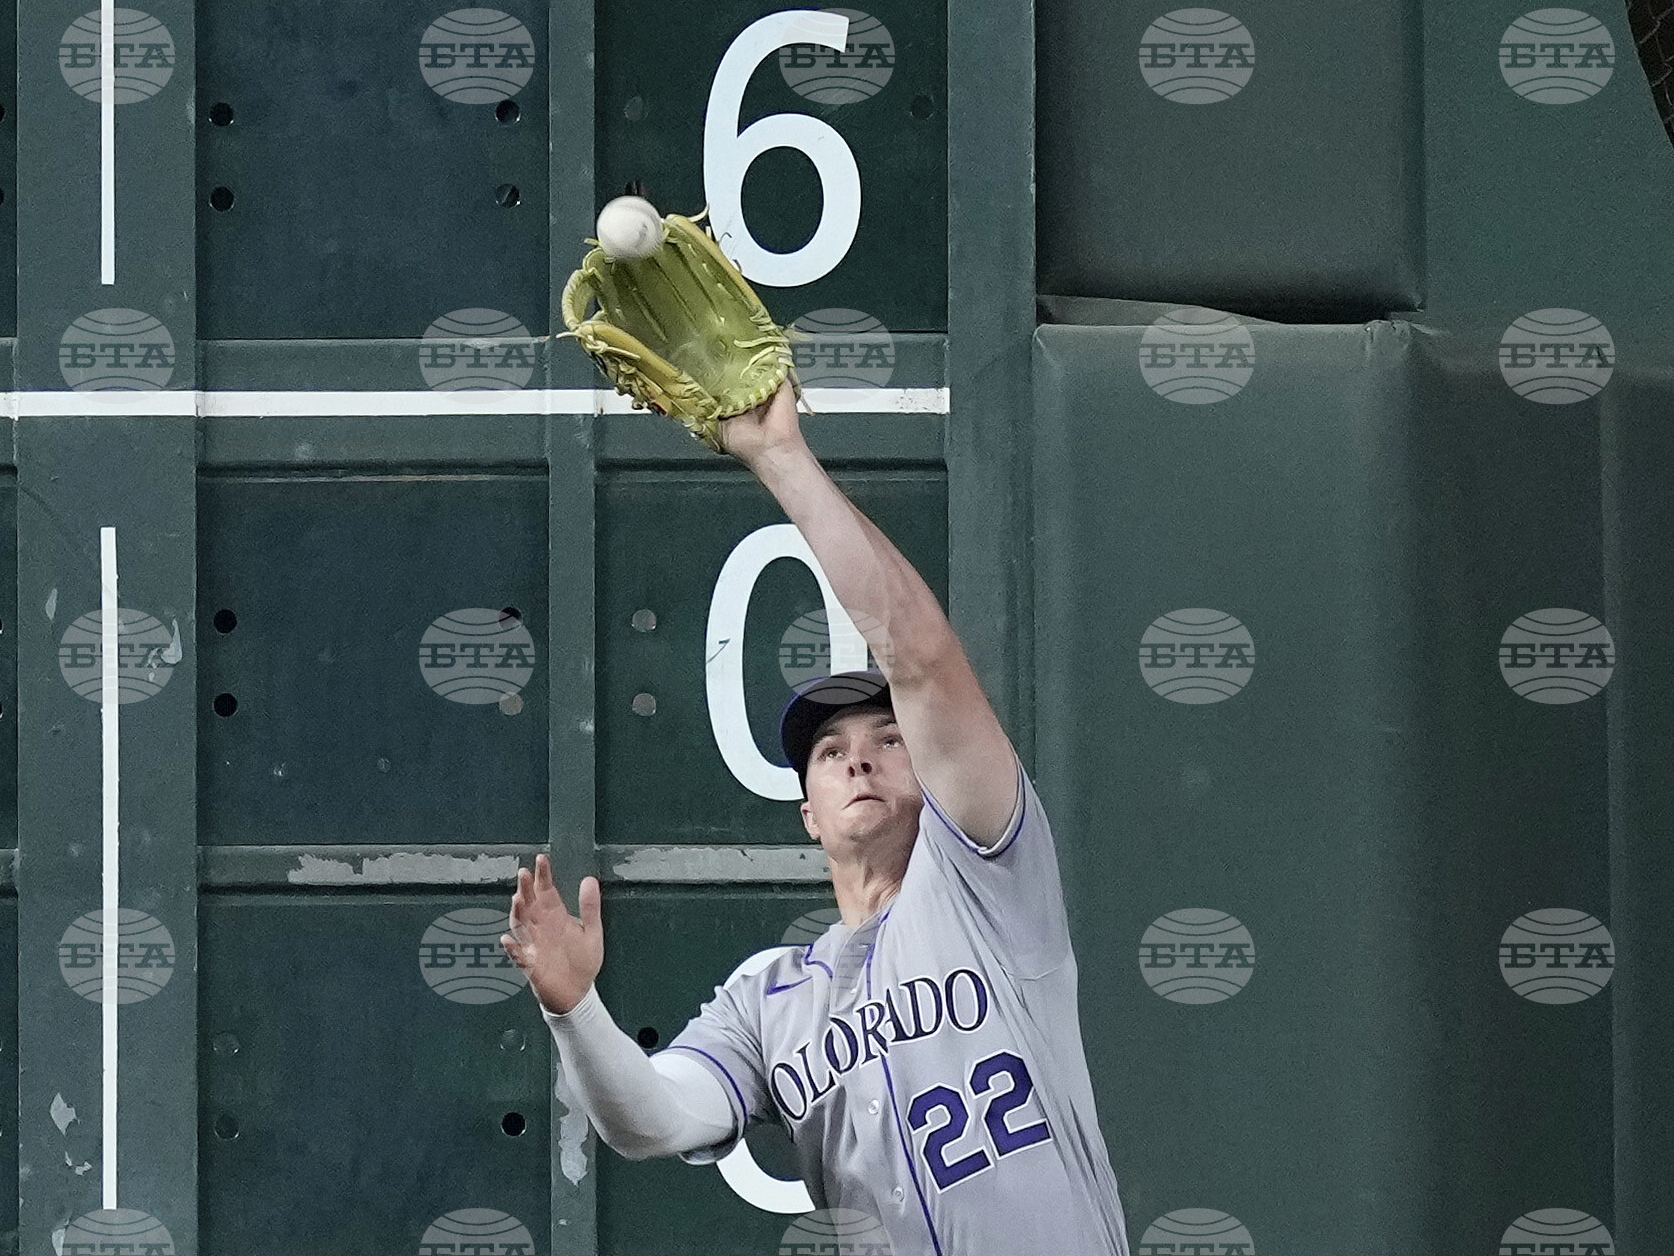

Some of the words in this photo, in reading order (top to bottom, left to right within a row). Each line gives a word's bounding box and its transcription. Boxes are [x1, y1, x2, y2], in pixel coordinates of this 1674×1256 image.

[703, 10, 861, 288] 6
[706, 523, 867, 801] 0
[769, 966, 989, 1123] OLORADO
[906, 1049, 1052, 1194] 22
